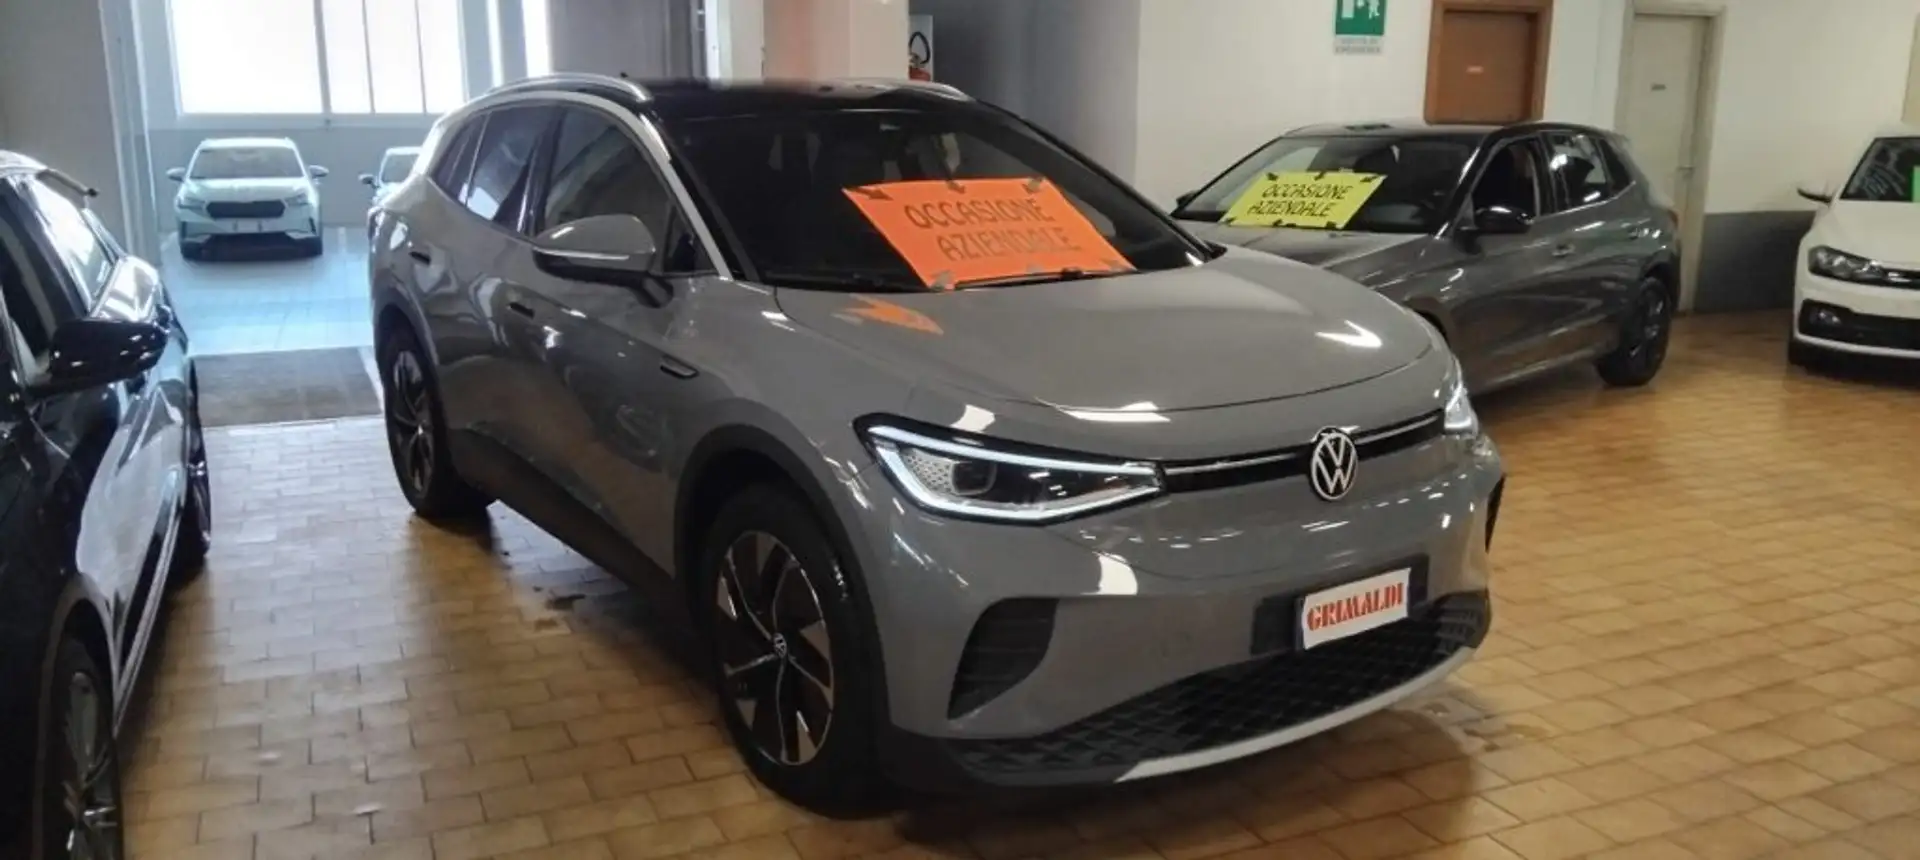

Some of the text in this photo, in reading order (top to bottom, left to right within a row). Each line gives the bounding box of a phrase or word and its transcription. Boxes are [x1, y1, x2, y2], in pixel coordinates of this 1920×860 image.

[1262, 183, 1353, 200] OCCASIONE
[904, 197, 1055, 229] OCCASIONE
[1247, 200, 1337, 217] AZIENDALE
[936, 227, 1082, 261] AZIENDALE
[1307, 582, 1403, 631] GRIMALDI
